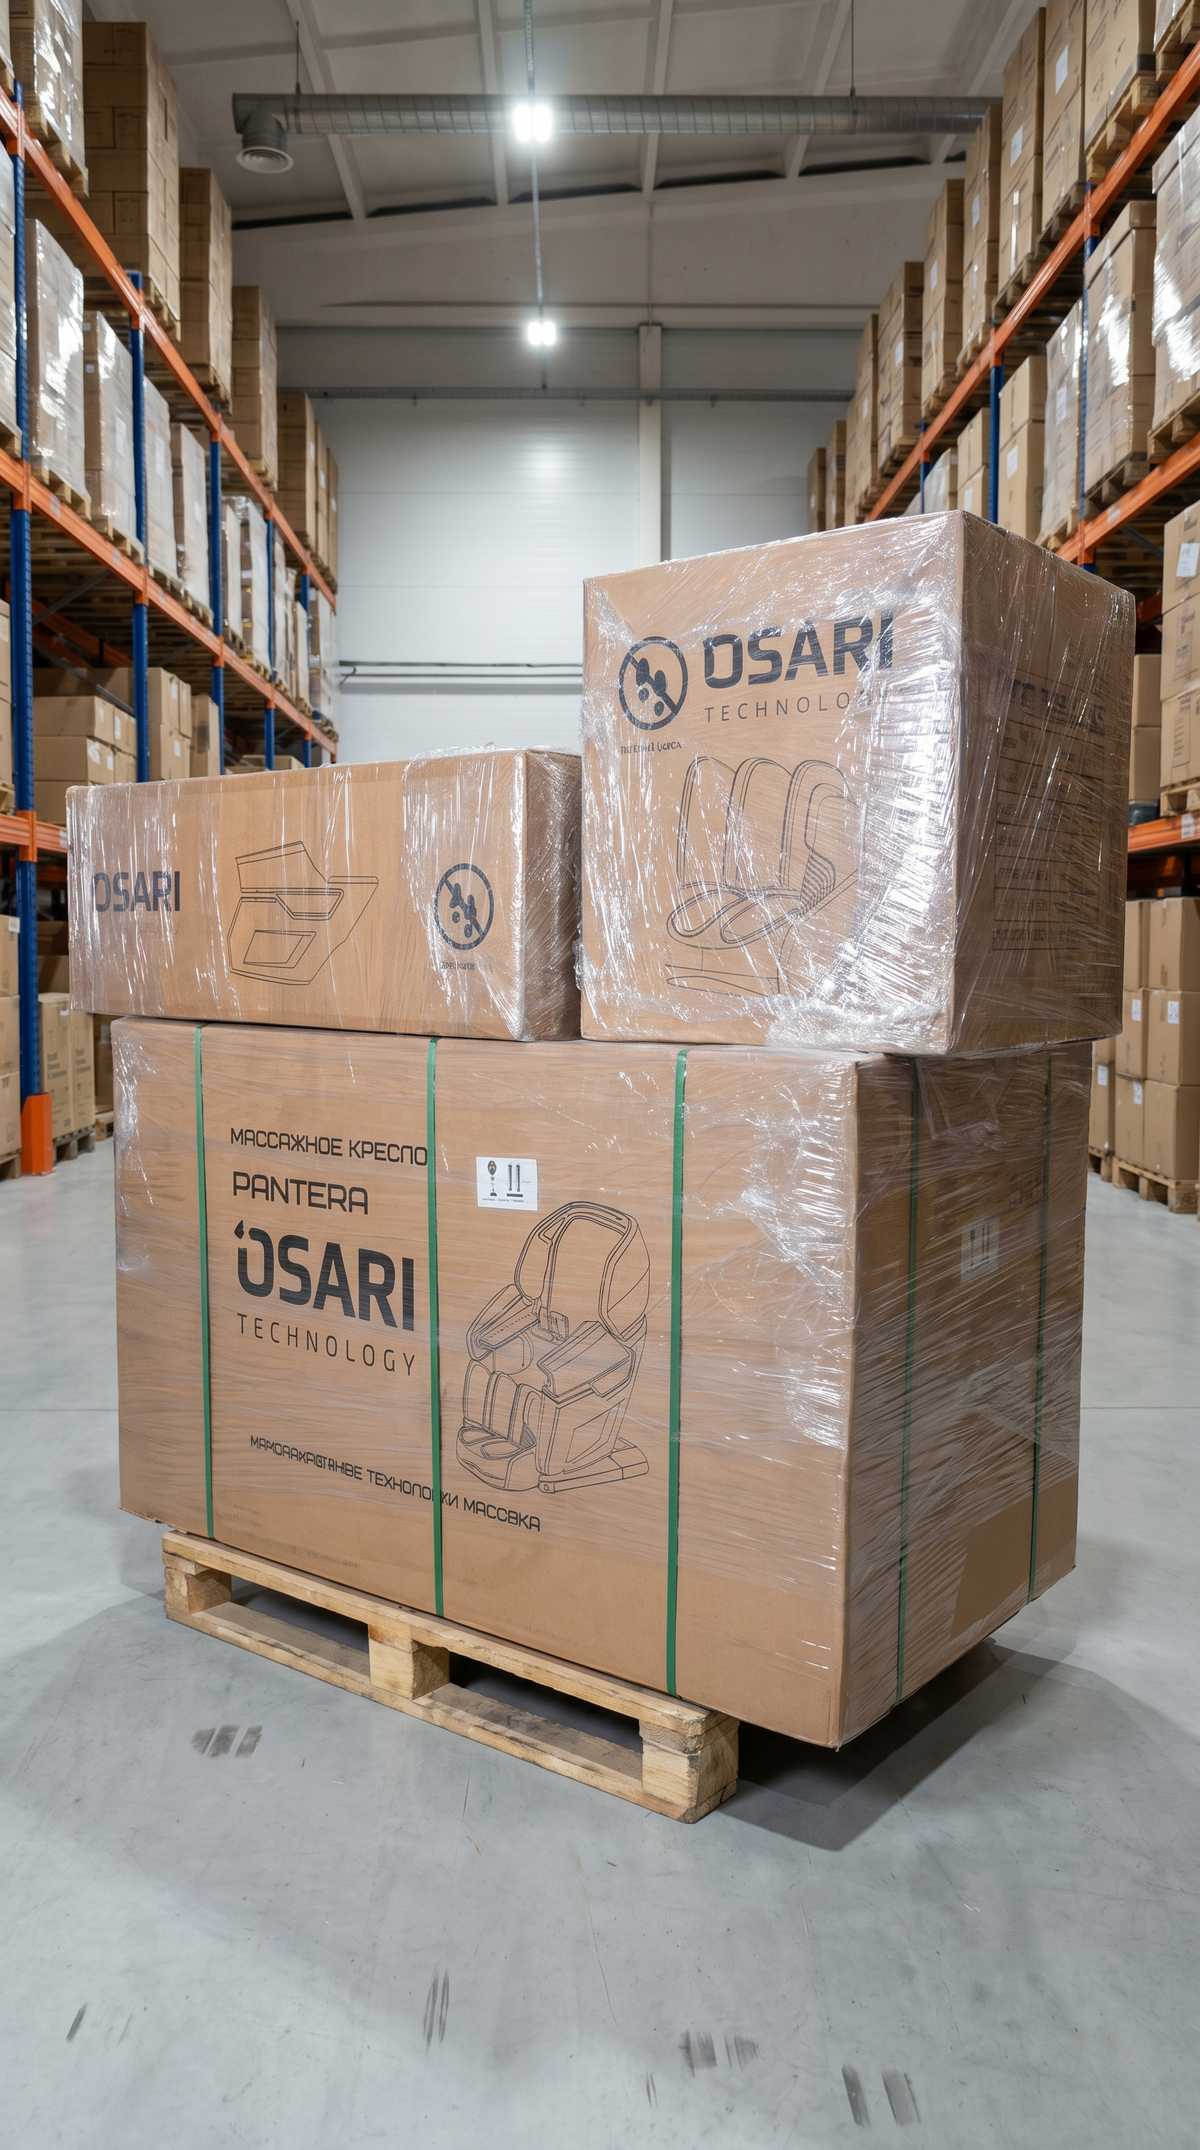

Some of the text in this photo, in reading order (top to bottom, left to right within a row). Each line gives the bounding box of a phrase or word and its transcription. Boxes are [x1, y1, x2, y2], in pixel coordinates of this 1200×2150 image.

[703, 609, 894, 689] OSARI
[93, 870, 180, 913] OSARI
[230, 1127, 343, 1157] МАССАЖНОЕ
[232, 1170, 369, 1215] PANTERA
[233, 1219, 415, 1332] OSARI
[236, 1312, 416, 1377] TECHNOLOGY
